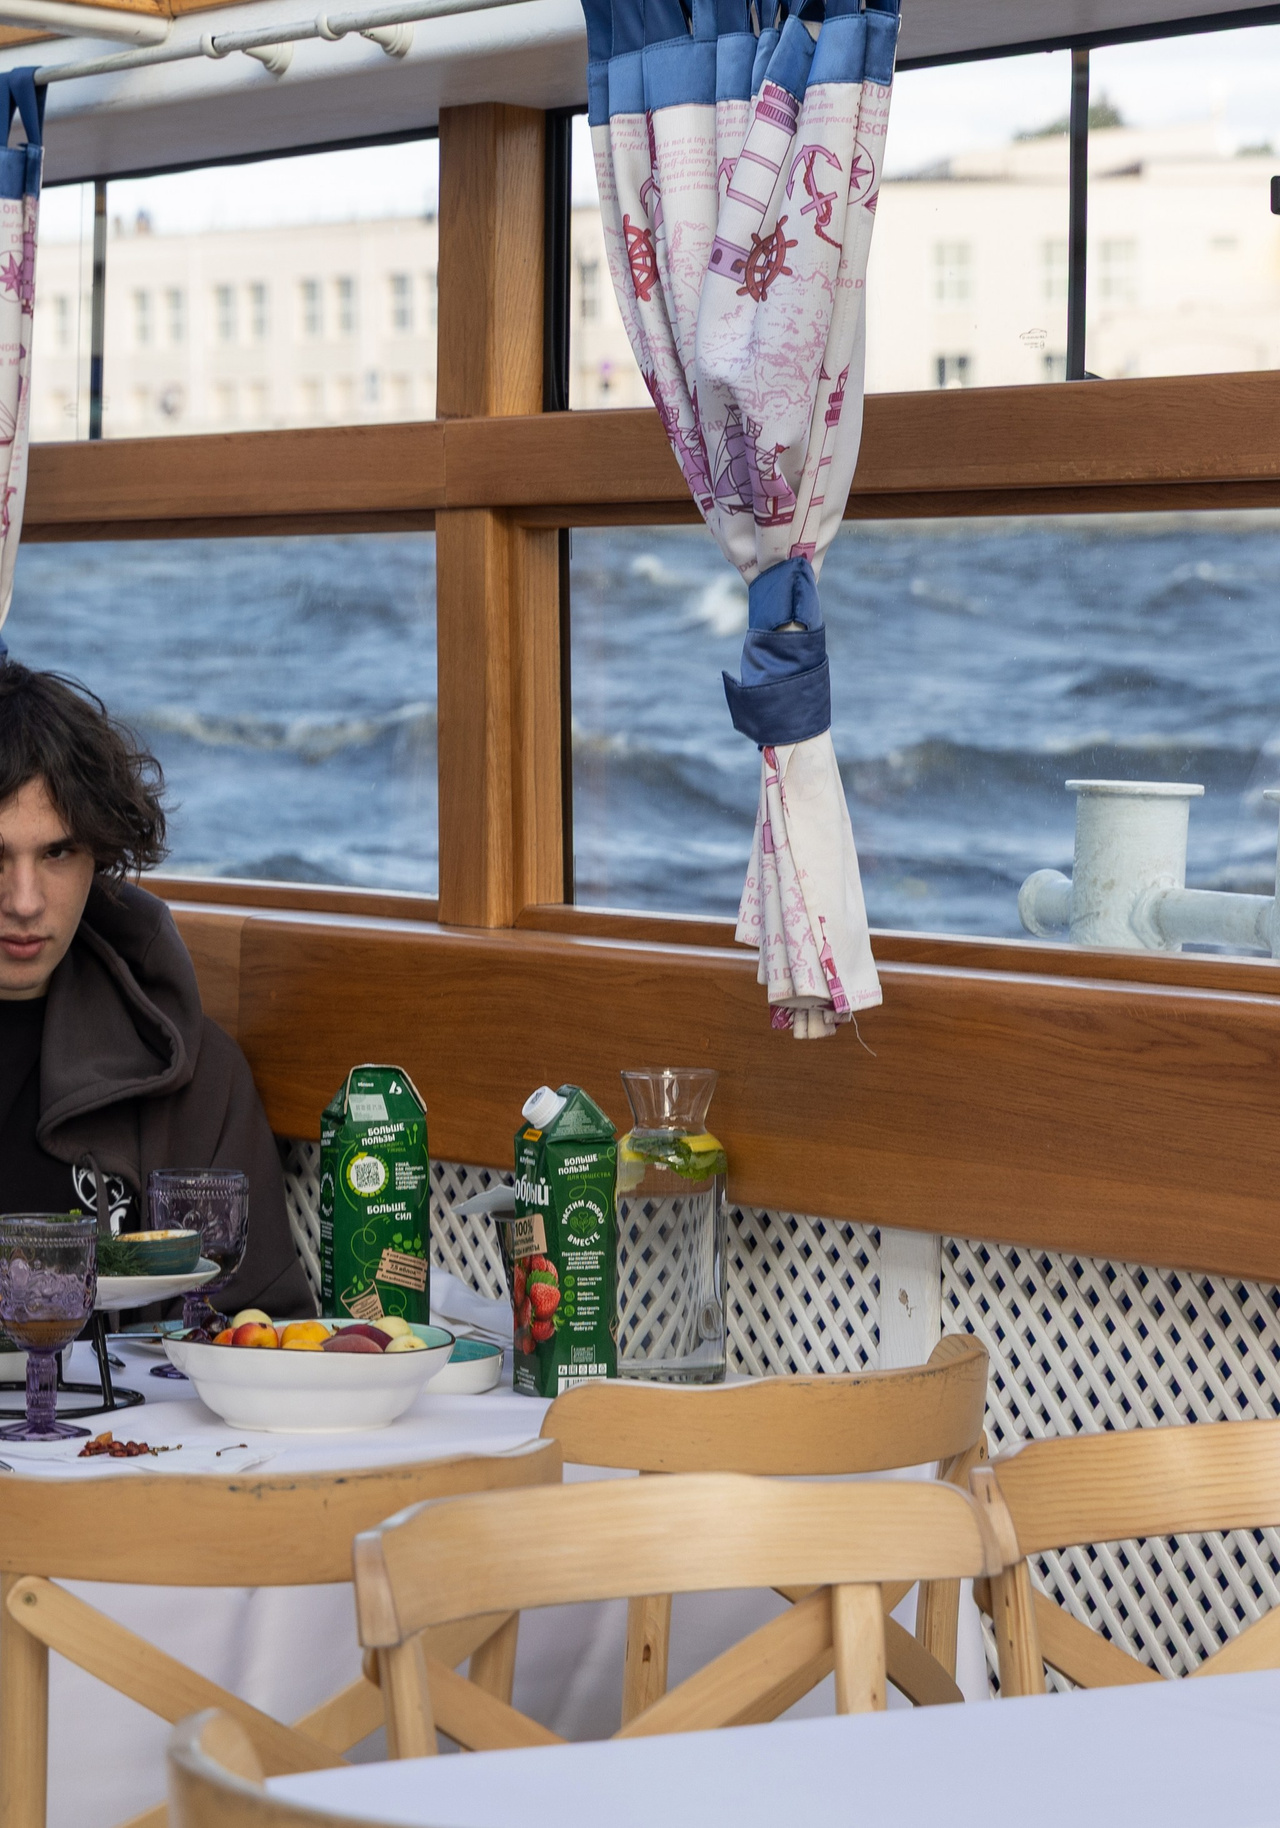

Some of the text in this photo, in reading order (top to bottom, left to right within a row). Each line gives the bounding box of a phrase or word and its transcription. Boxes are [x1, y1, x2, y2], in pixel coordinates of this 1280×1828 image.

[825, 116, 852, 125] process
[368, 1122, 405, 1137] БОЛЬШЕ
[361, 1133, 396, 1146] ПОЛЬЗЫ
[564, 1153, 598, 1167] БОЛЬШЕ
[558, 1164, 589, 1176] ПОЛЬЗЫ
[567, 1171, 611, 1181] ДЛЯ ОБЩЕСТВА
[515, 1174, 549, 1207] обрый
[367, 1202, 406, 1215] БОЛЬШЕ
[562, 1200, 605, 1225] РАСТИМ ДОБРО
[395, 1212, 412, 1220] СИЛ
[567, 1231, 600, 1247] ВМЕСТЕ
